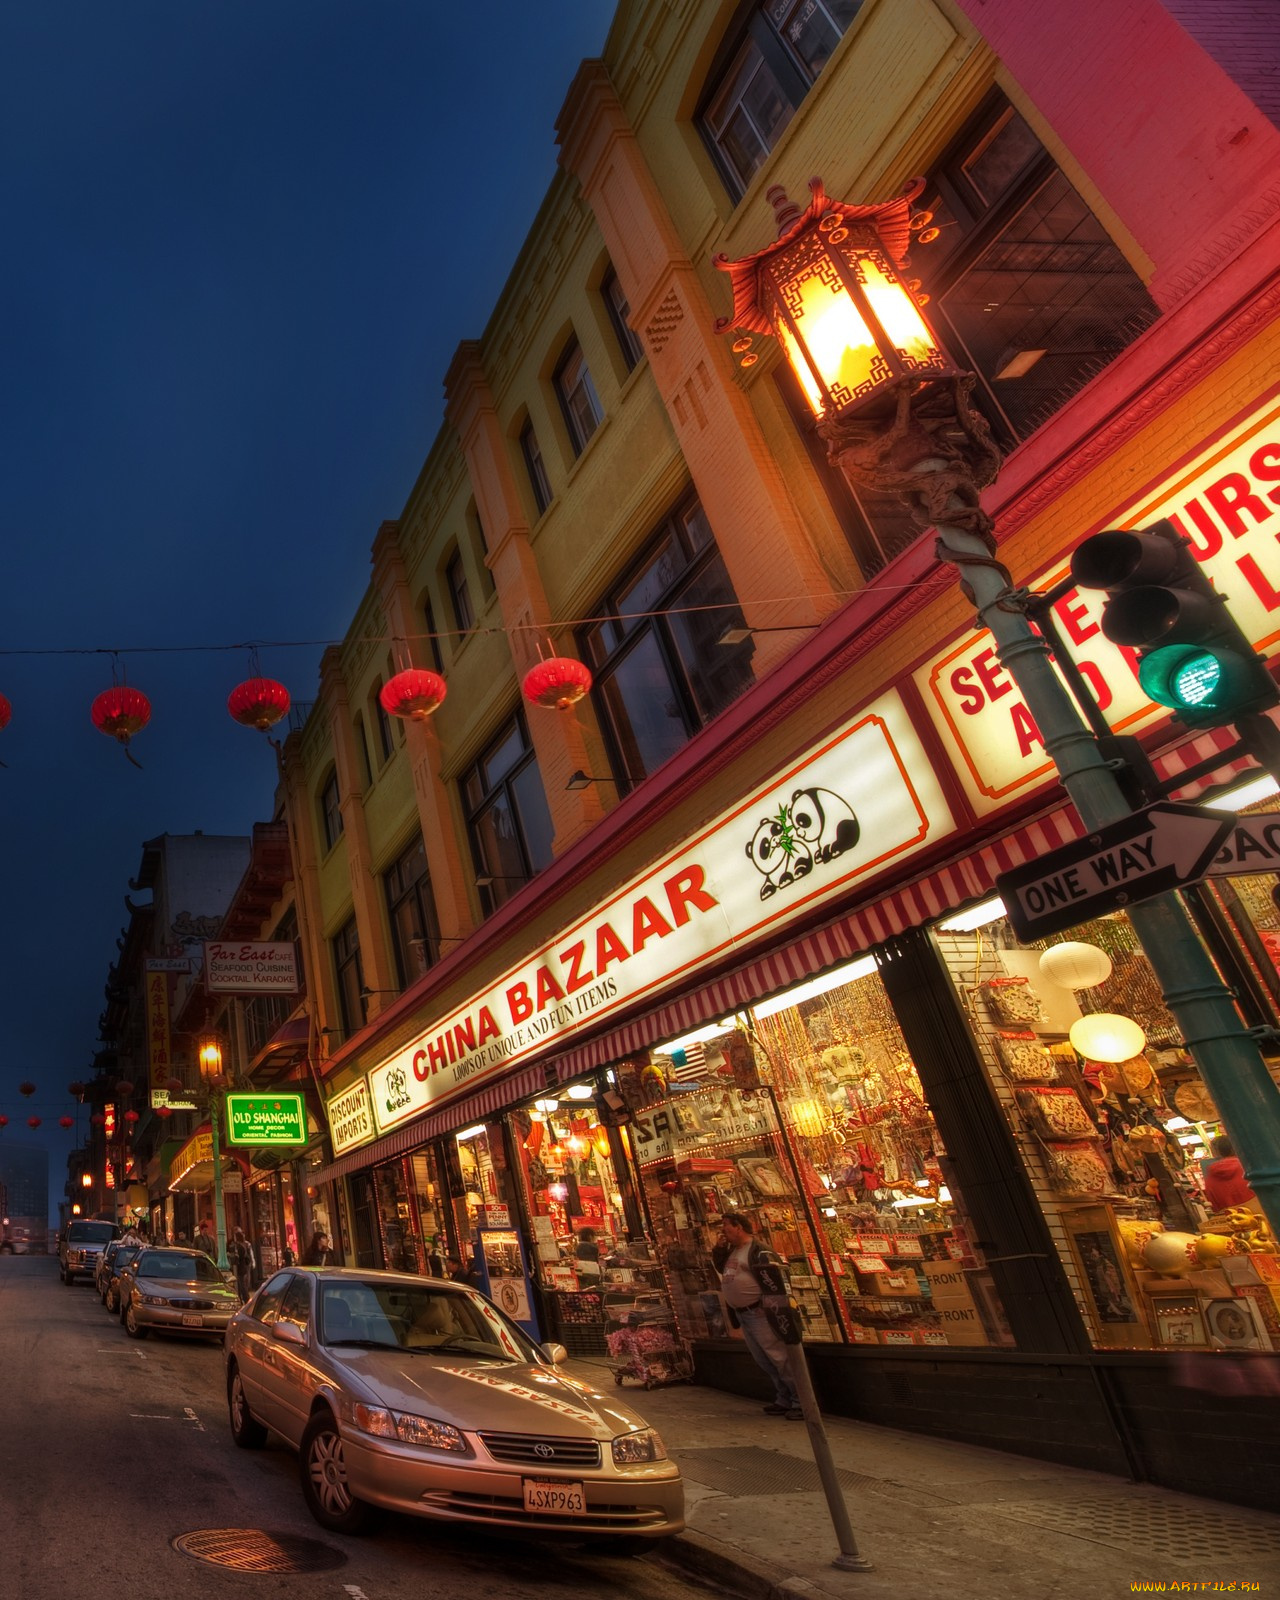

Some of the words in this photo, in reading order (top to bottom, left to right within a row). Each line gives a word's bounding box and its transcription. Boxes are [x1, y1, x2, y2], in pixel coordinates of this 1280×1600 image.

[1024, 868, 1088, 914] ONE
[1089, 836, 1159, 887] WAY
[208, 944, 236, 962] Far
[238, 945, 275, 962] East
[148, 960, 163, 969] Far
[166, 960, 187, 969] East
[412, 1004, 503, 1082] CHINA
[505, 863, 721, 1027] BAZAAR
[474, 1050, 488, 1070] OF
[488, 1029, 526, 1062] UNIQUE
[527, 1017, 549, 1042] AND
[550, 1001, 574, 1030] FUN
[575, 977, 618, 1015] ITEMS
[330, 1087, 366, 1126] DISCOUNT
[233, 1112, 251, 1124] OLD
[253, 1112, 299, 1124] SHANGHAI
[335, 1113, 368, 1146] IMPORTS
[927, 1272, 964, 1286] FRONT
[937, 1309, 975, 1321] FRONT
[528, 1489, 582, 1510] 4SXP963
